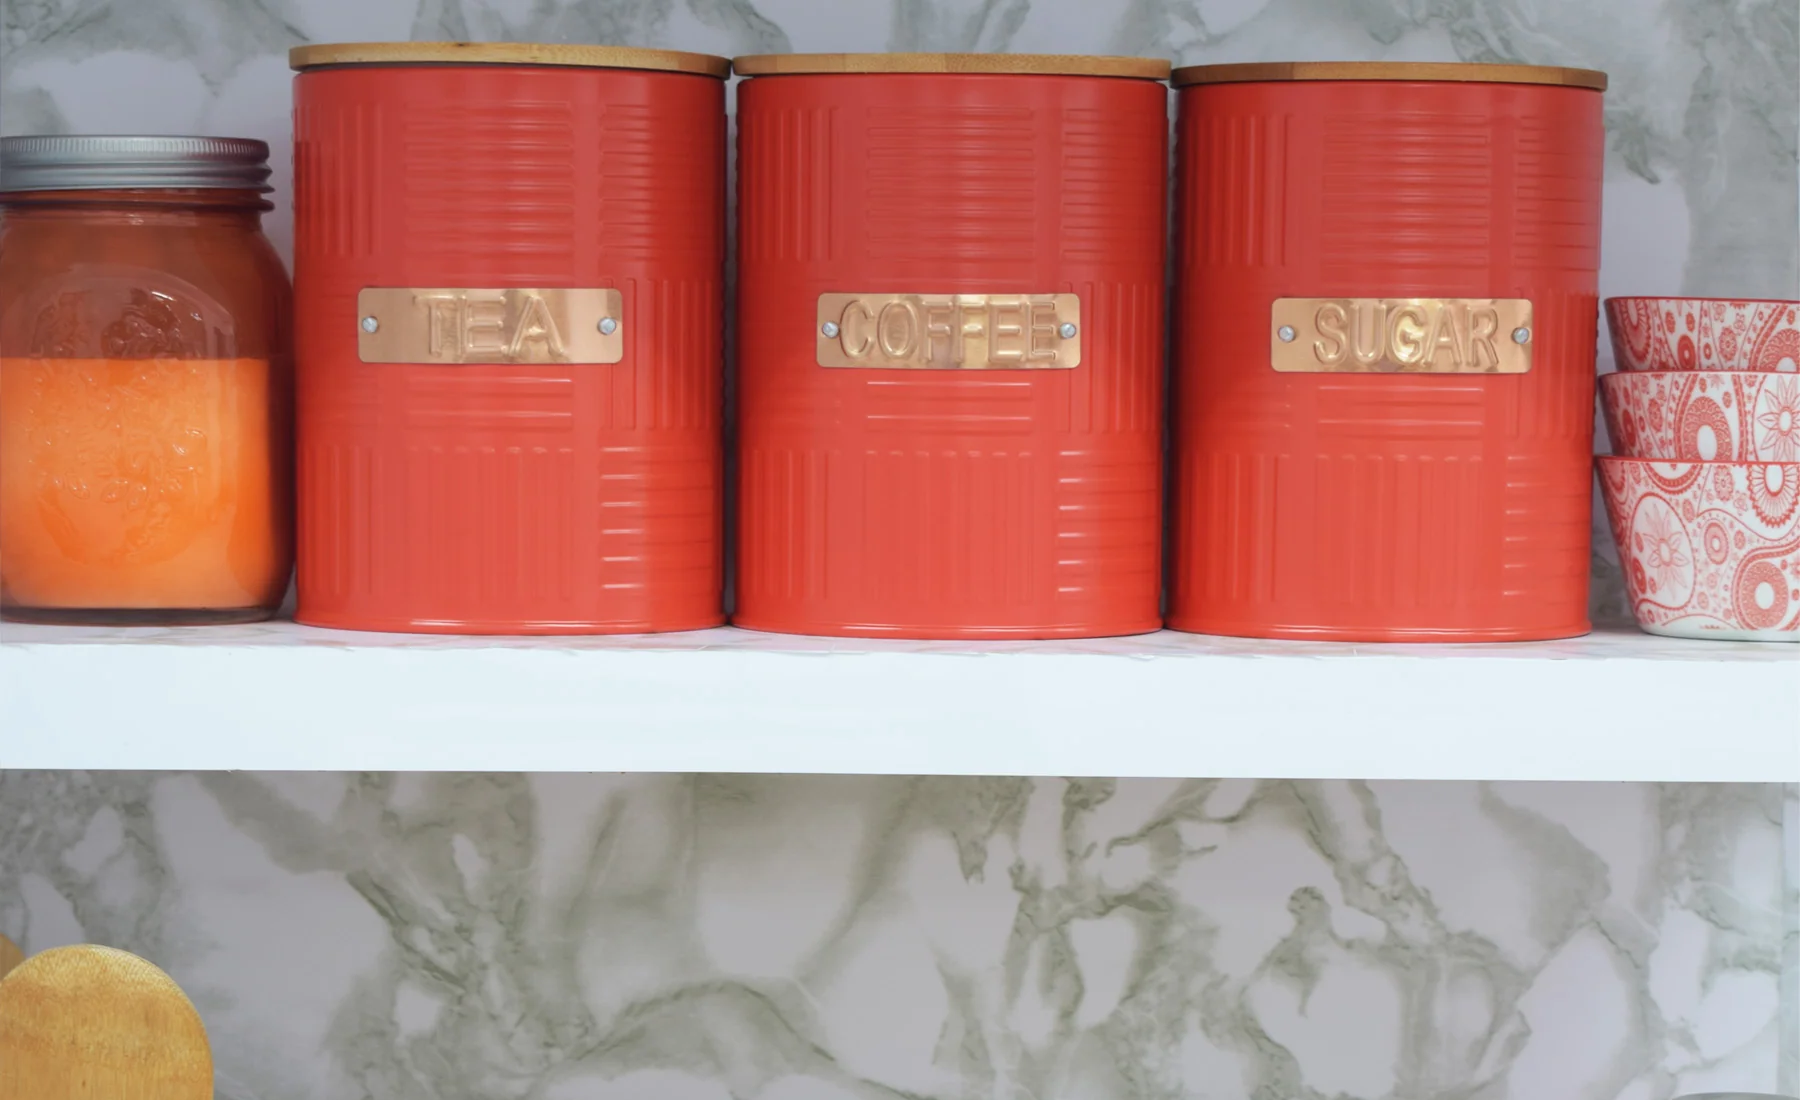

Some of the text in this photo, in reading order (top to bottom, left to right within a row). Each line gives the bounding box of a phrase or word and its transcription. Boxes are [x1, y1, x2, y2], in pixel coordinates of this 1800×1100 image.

[412, 293, 568, 360] TEA
[839, 299, 1056, 361] COFFEE
[1313, 303, 1499, 366] SUGAR
